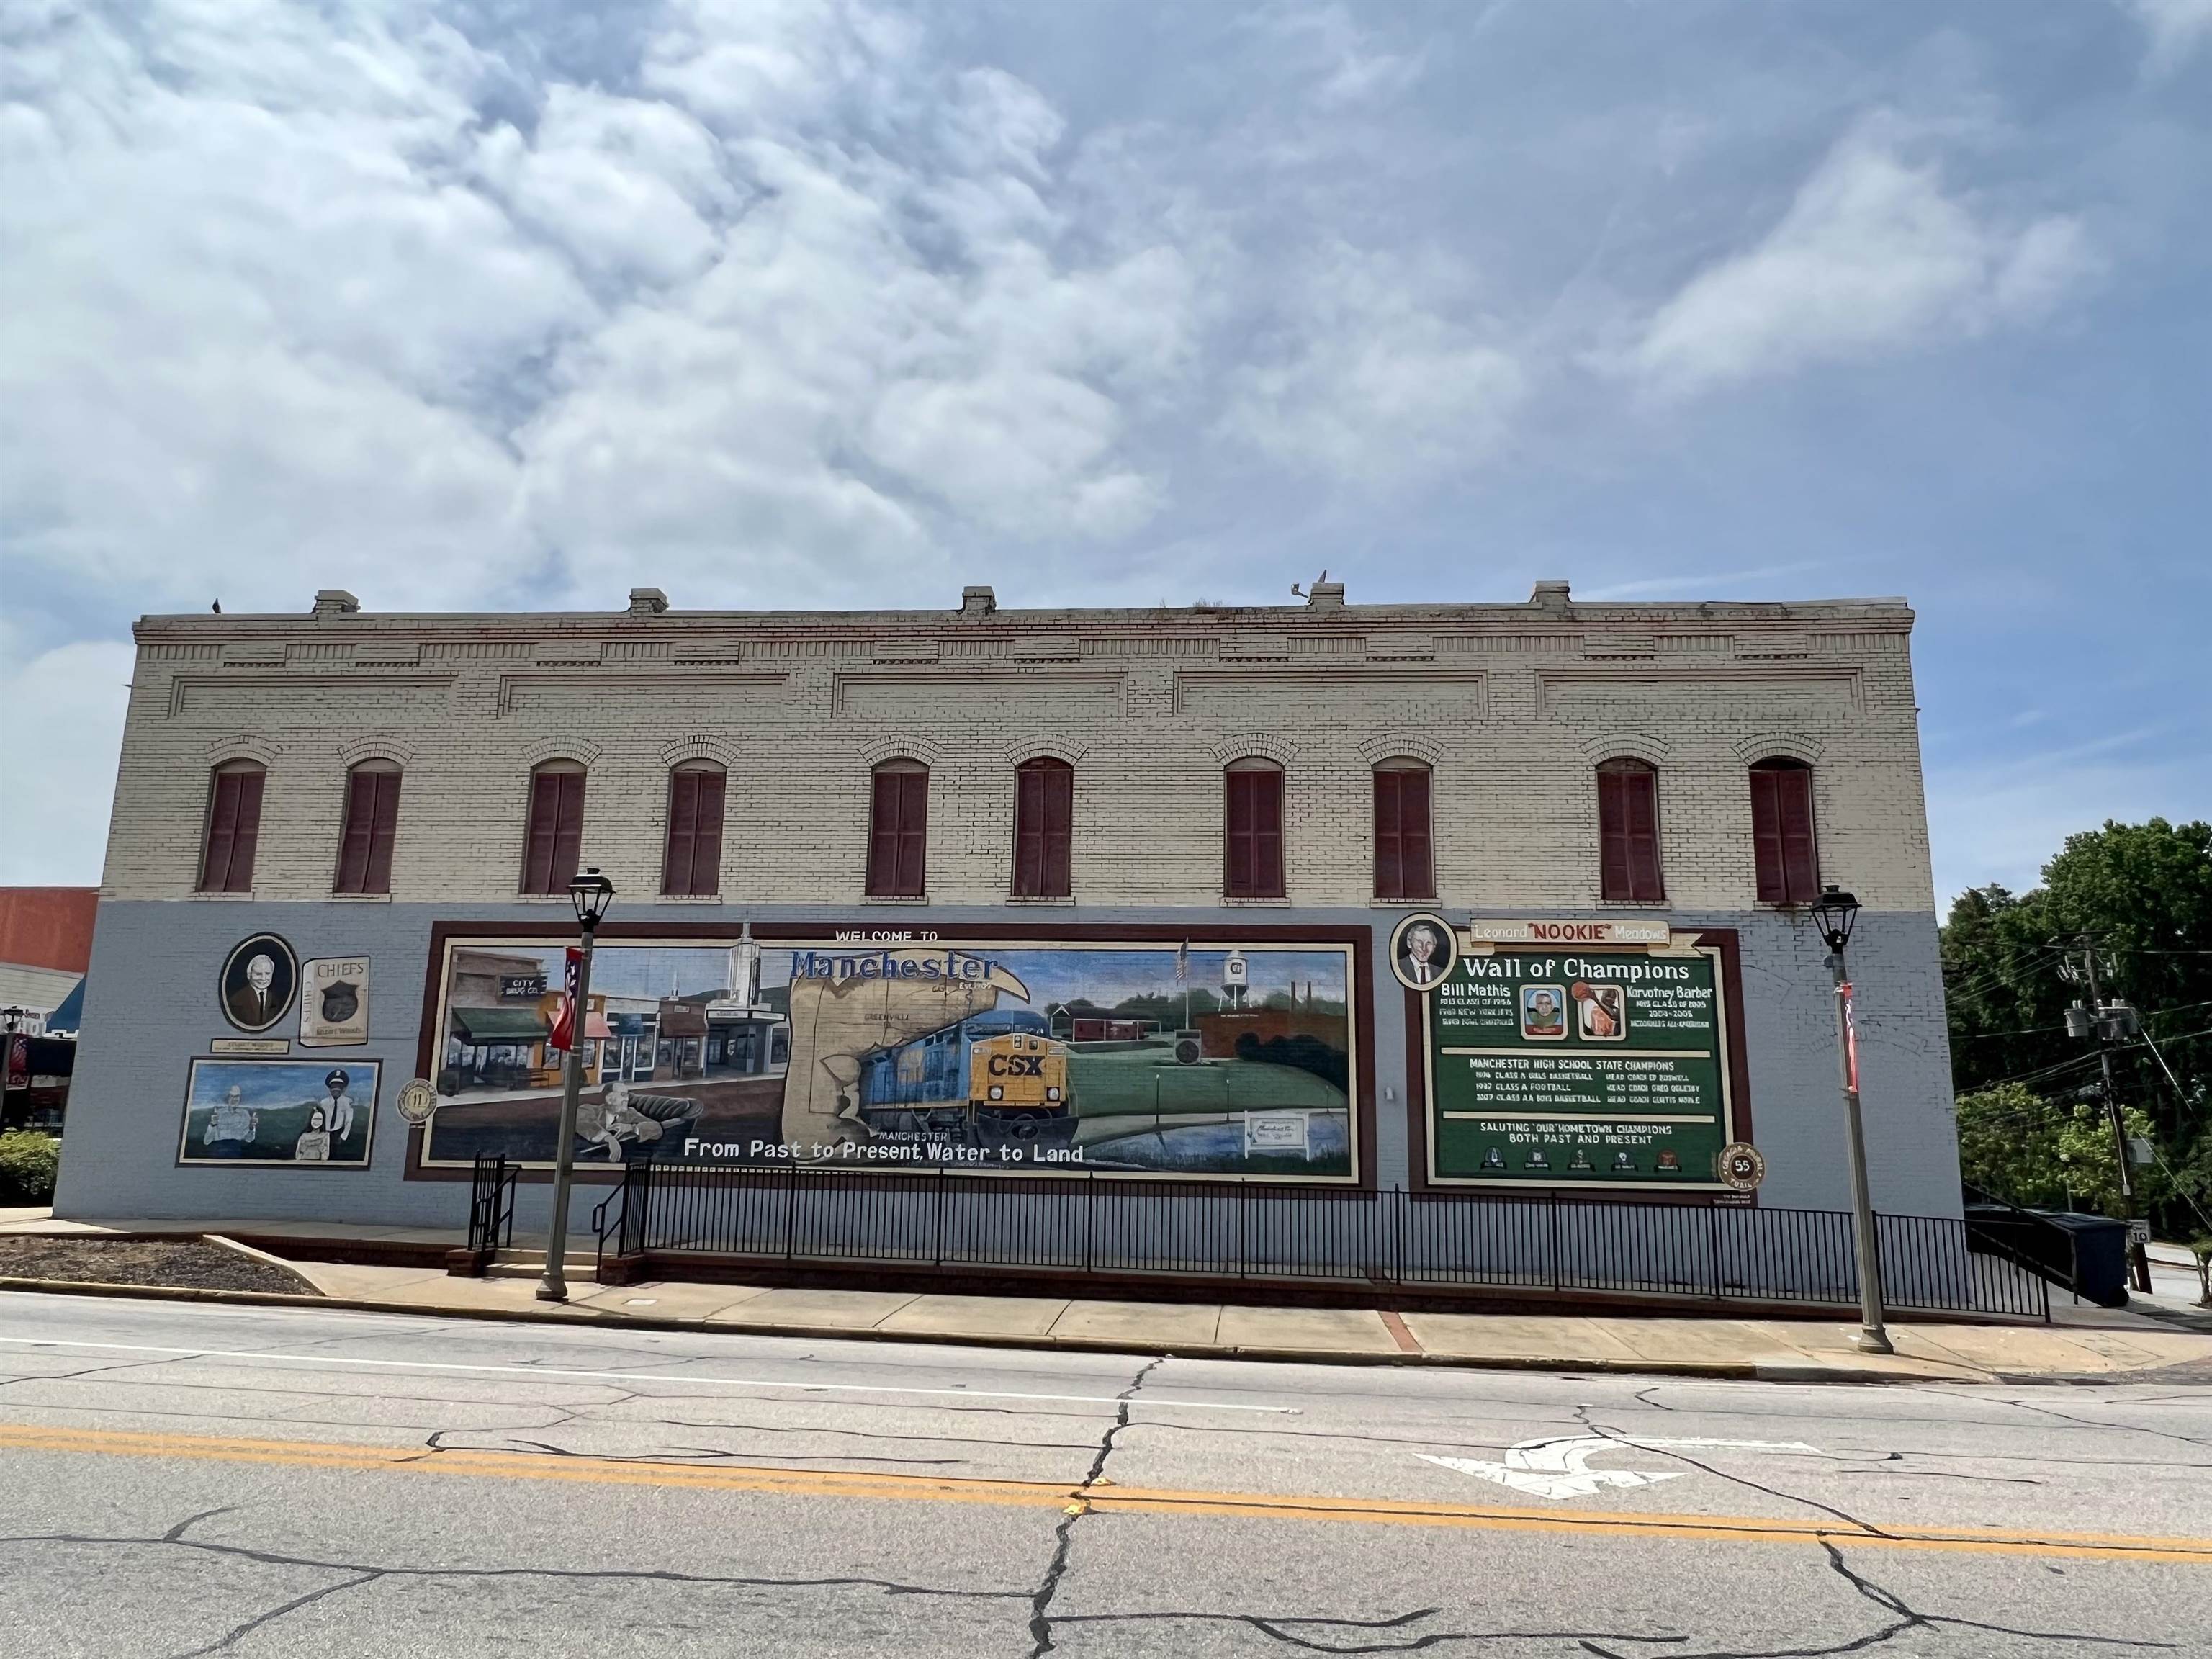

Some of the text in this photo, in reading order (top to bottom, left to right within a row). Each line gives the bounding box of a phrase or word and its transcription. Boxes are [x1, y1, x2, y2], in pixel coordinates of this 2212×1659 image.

[836, 931, 938, 941] WELCOME TO
[1475, 925, 1527, 938] Leonard
[1614, 927, 1666, 940] Meadows
[318, 963, 364, 978] CHIEFS
[791, 951, 997, 979] Manchester
[1463, 958, 1689, 983] Wall of Champions
[1441, 983, 1511, 997] Bill Mathis
[1676, 986, 1712, 998] Barber
[989, 1054, 1045, 1076] CSX
[1470, 1059, 1674, 1071] MANCHESTER HIGH SCHOOL STATE CHAMPIONS
[1480, 1123, 1529, 1132] SALUTING
[1559, 1124, 1612, 1133] HOMETOWN
[1617, 1125, 1672, 1135] CHAMPIONS
[879, 1132, 948, 1141] MANCHESTER
[1509, 1133, 1653, 1144] BOTH PAST AND PRESENT
[684, 1138, 1084, 1163] From Past to Present, Water to Land
[1735, 1160, 1750, 1172] 55
[2134, 1232, 2147, 1241] 10
